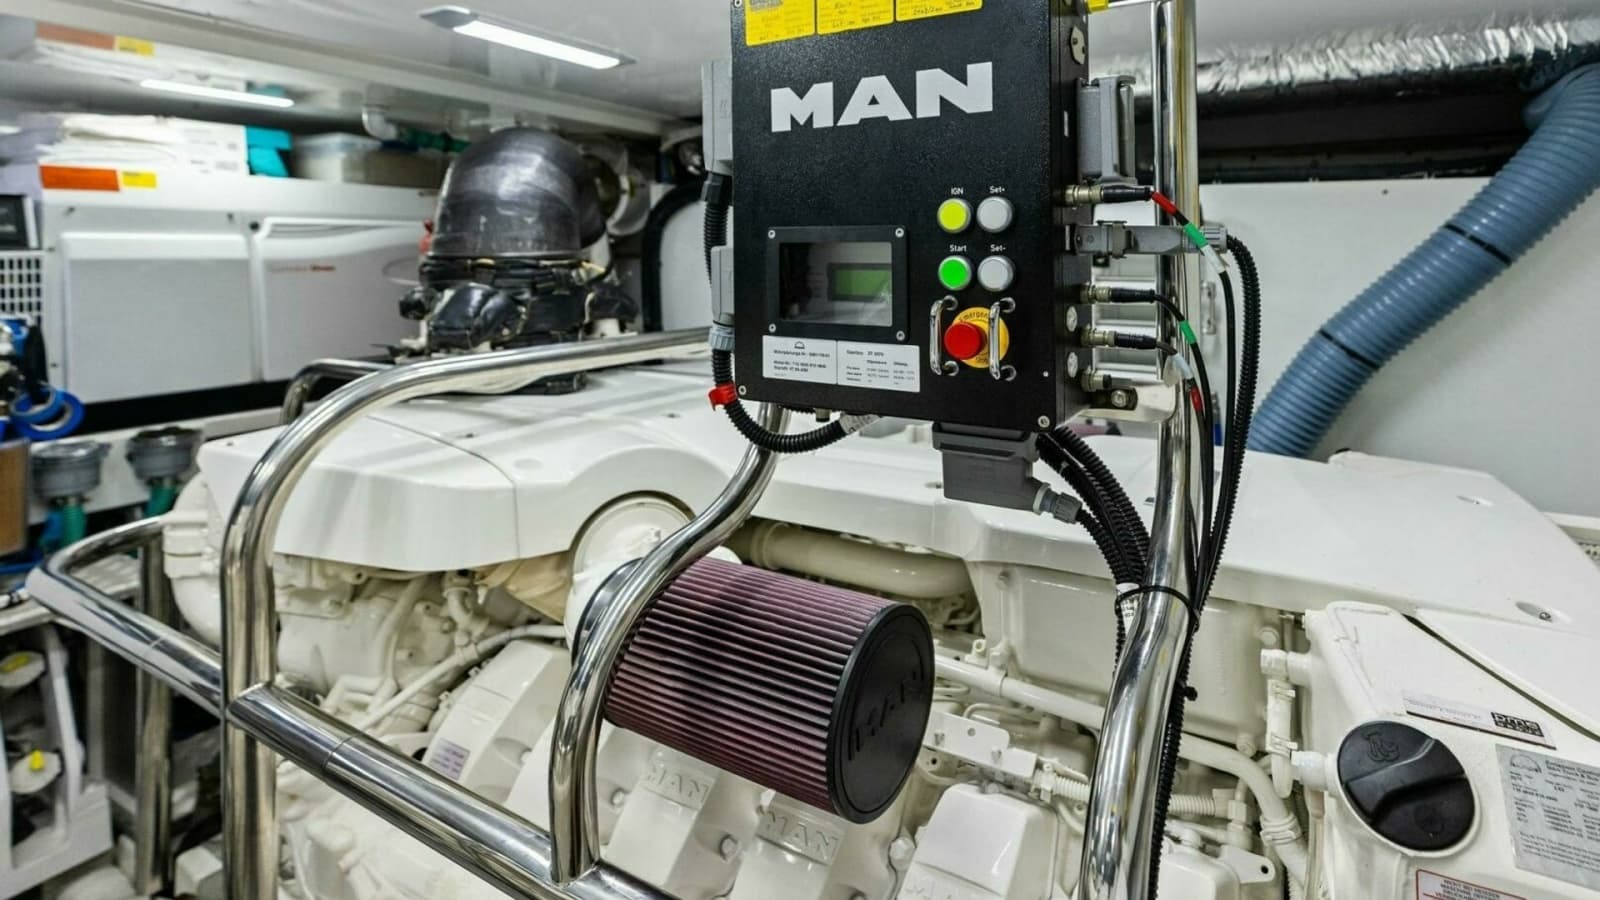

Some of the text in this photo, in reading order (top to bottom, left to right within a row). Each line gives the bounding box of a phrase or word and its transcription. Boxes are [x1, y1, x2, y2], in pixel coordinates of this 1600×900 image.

[771, 61, 993, 133] MAN
[950, 186, 964, 195] IGN
[949, 244, 967, 252] Start
